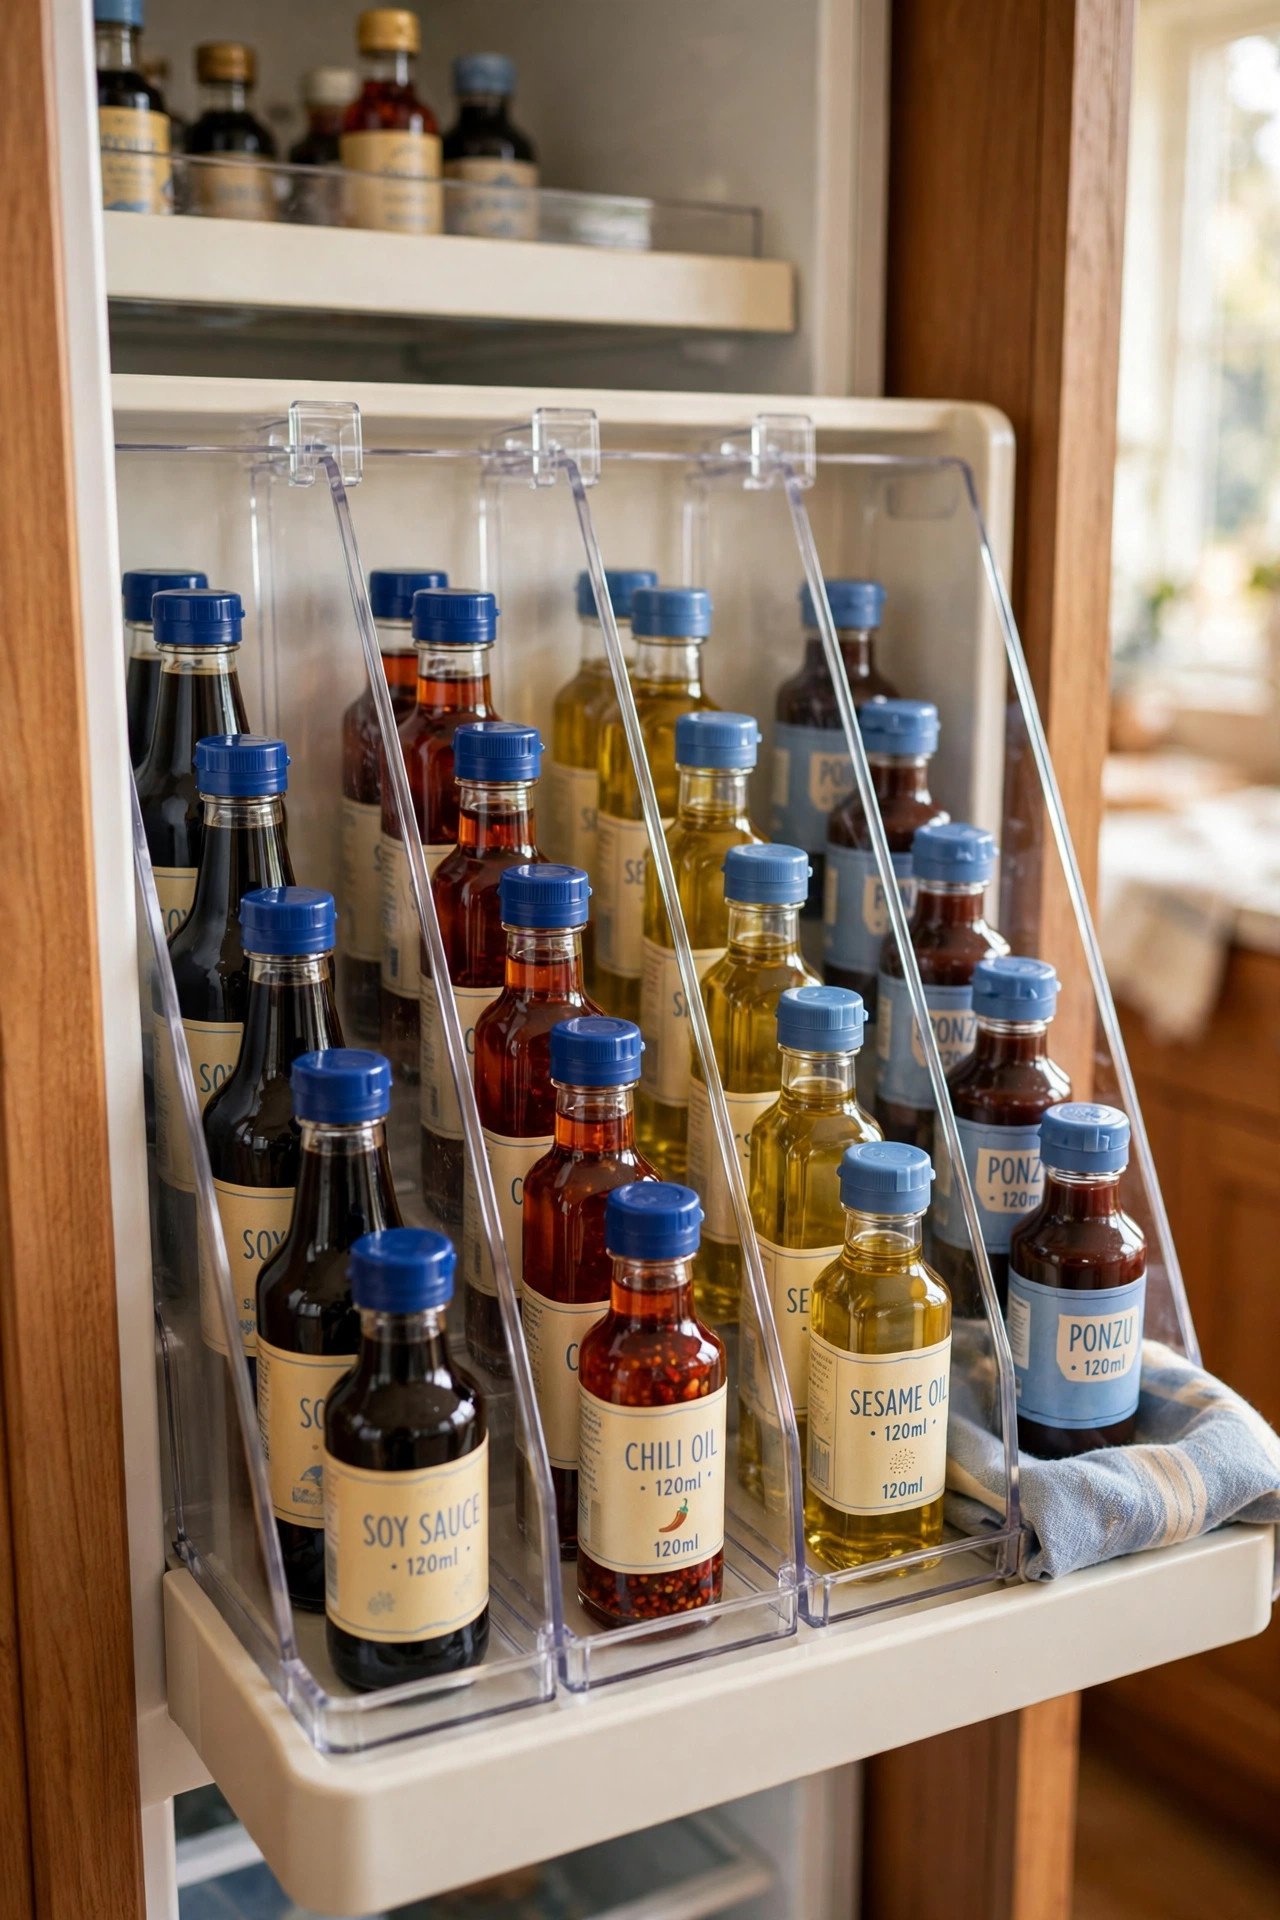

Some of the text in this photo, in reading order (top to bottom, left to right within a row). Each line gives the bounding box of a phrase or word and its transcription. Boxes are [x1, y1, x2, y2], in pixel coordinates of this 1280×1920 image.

[988, 1156, 1041, 1184] PONZ
[1003, 1191, 1040, 1208] 120m
[1069, 1315, 1133, 1352] PONZU
[1084, 1354, 1125, 1376] 120ml
[850, 1375, 947, 1417] SESAME OIL
[884, 1417, 927, 1442] 120ml
[625, 1428, 718, 1472] CHILI OIL
[655, 1471, 701, 1496] 120ml
[882, 1476, 923, 1500] 120ml
[363, 1492, 480, 1548] SOY SAUCE
[654, 1533, 699, 1559] 120ml
[406, 1546, 459, 1577] 120ml
